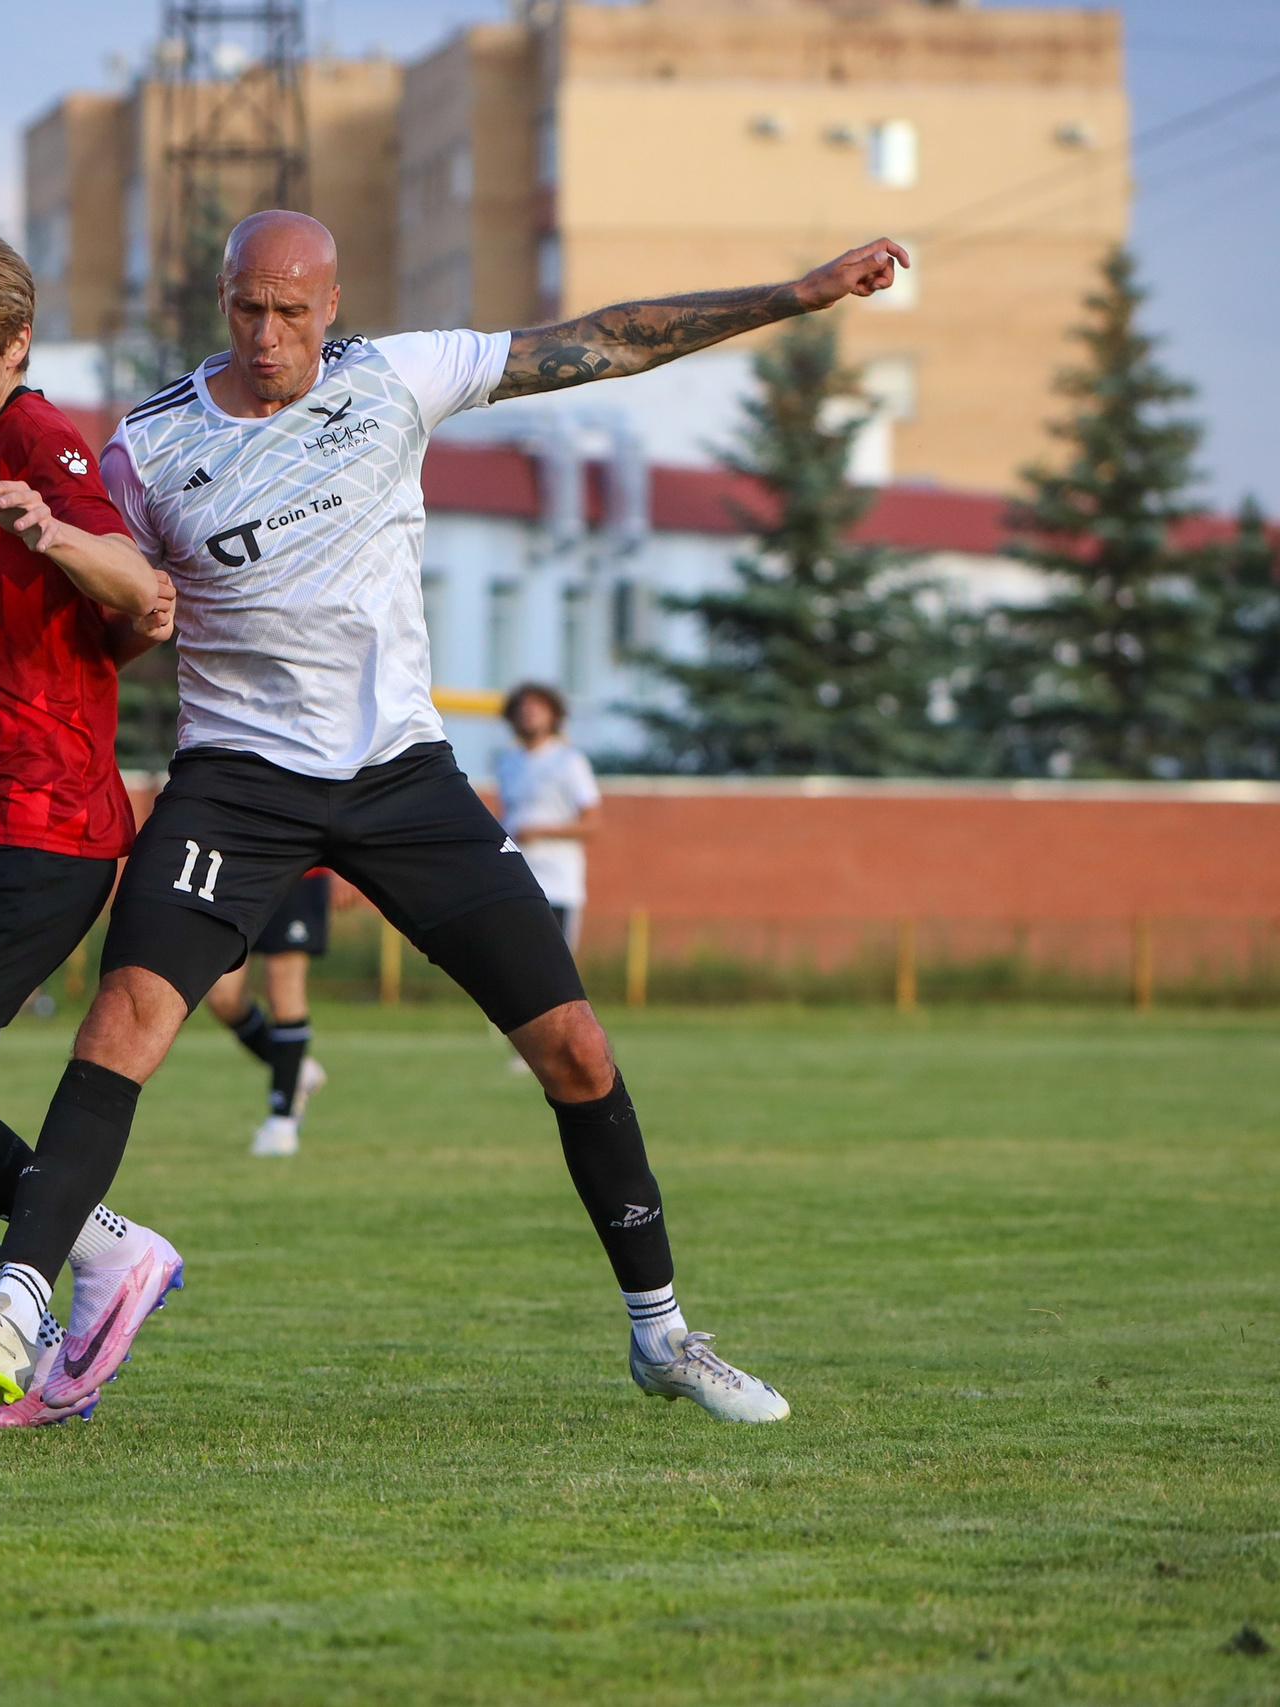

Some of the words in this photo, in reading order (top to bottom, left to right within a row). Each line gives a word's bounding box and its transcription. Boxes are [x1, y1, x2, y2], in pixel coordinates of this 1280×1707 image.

[303, 418, 380, 449] ЧАЙКА
[322, 436, 370, 457] САМАРА
[266, 508, 307, 531] Coin
[309, 493, 343, 514] Tab
[173, 839, 224, 903] 11
